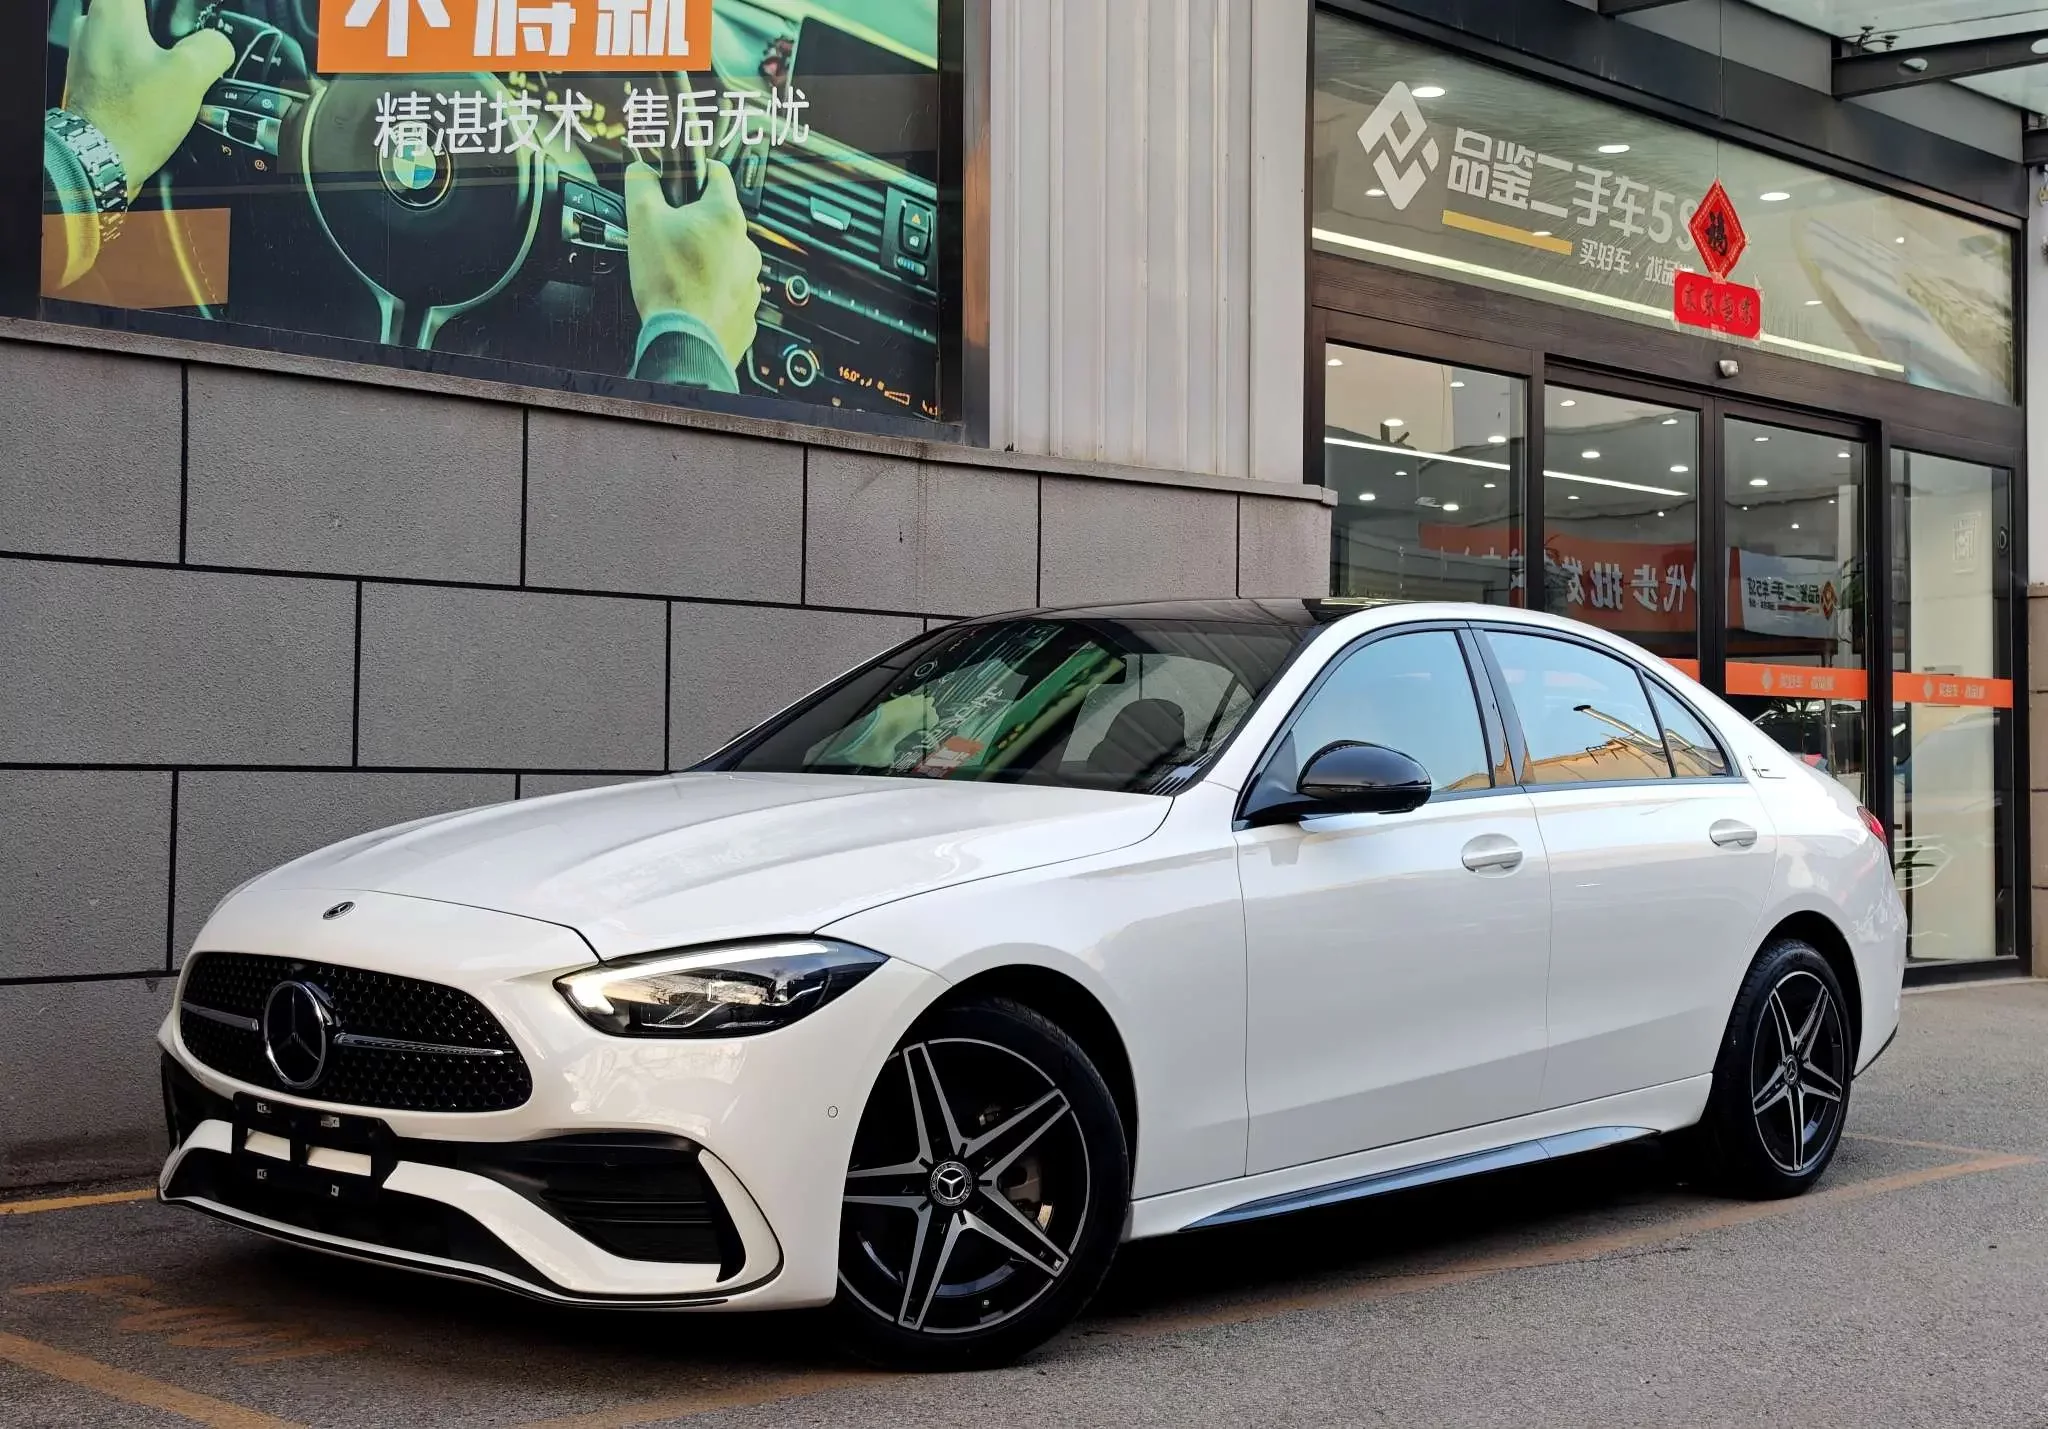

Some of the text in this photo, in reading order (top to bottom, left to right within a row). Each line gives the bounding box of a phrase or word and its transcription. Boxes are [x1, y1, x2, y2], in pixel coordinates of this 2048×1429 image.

[373, 87, 811, 159] 精湛技术 售后无忧
